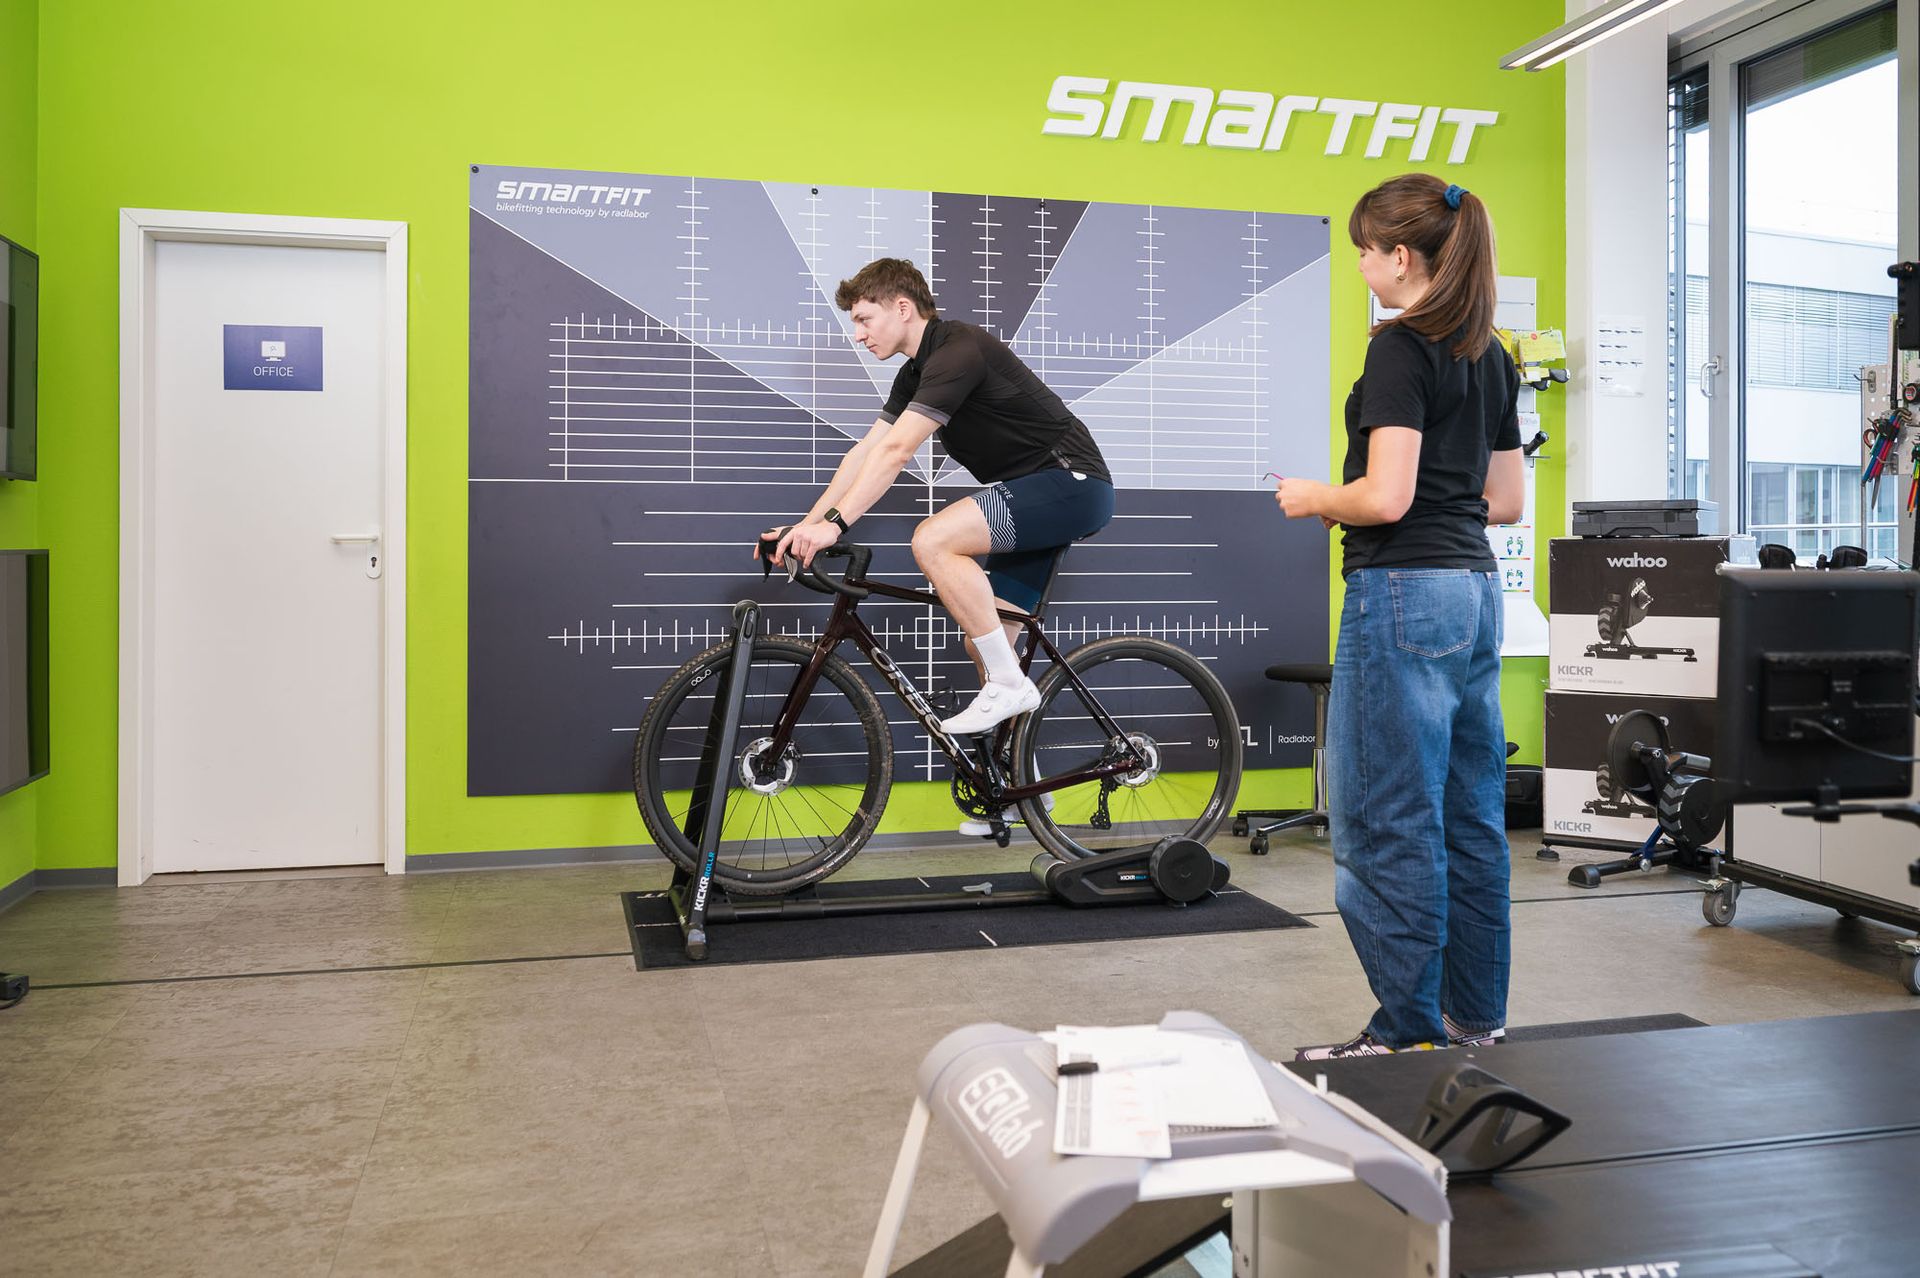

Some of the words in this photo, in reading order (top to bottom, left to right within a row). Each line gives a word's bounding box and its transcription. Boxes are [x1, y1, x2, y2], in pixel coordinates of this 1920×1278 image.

[496, 202, 543, 215] bikefitting
[546, 206, 596, 218] technology
[598, 209, 610, 219] by
[612, 209, 649, 219] radlabor
[253, 366, 294, 377] OFFICE
[1606, 552, 1668, 568] wahoo
[1557, 665, 1594, 676] KICKR
[1207, 736, 1220, 749] by
[1553, 820, 1592, 833] KICKR
[694, 876, 710, 911] KICKR
